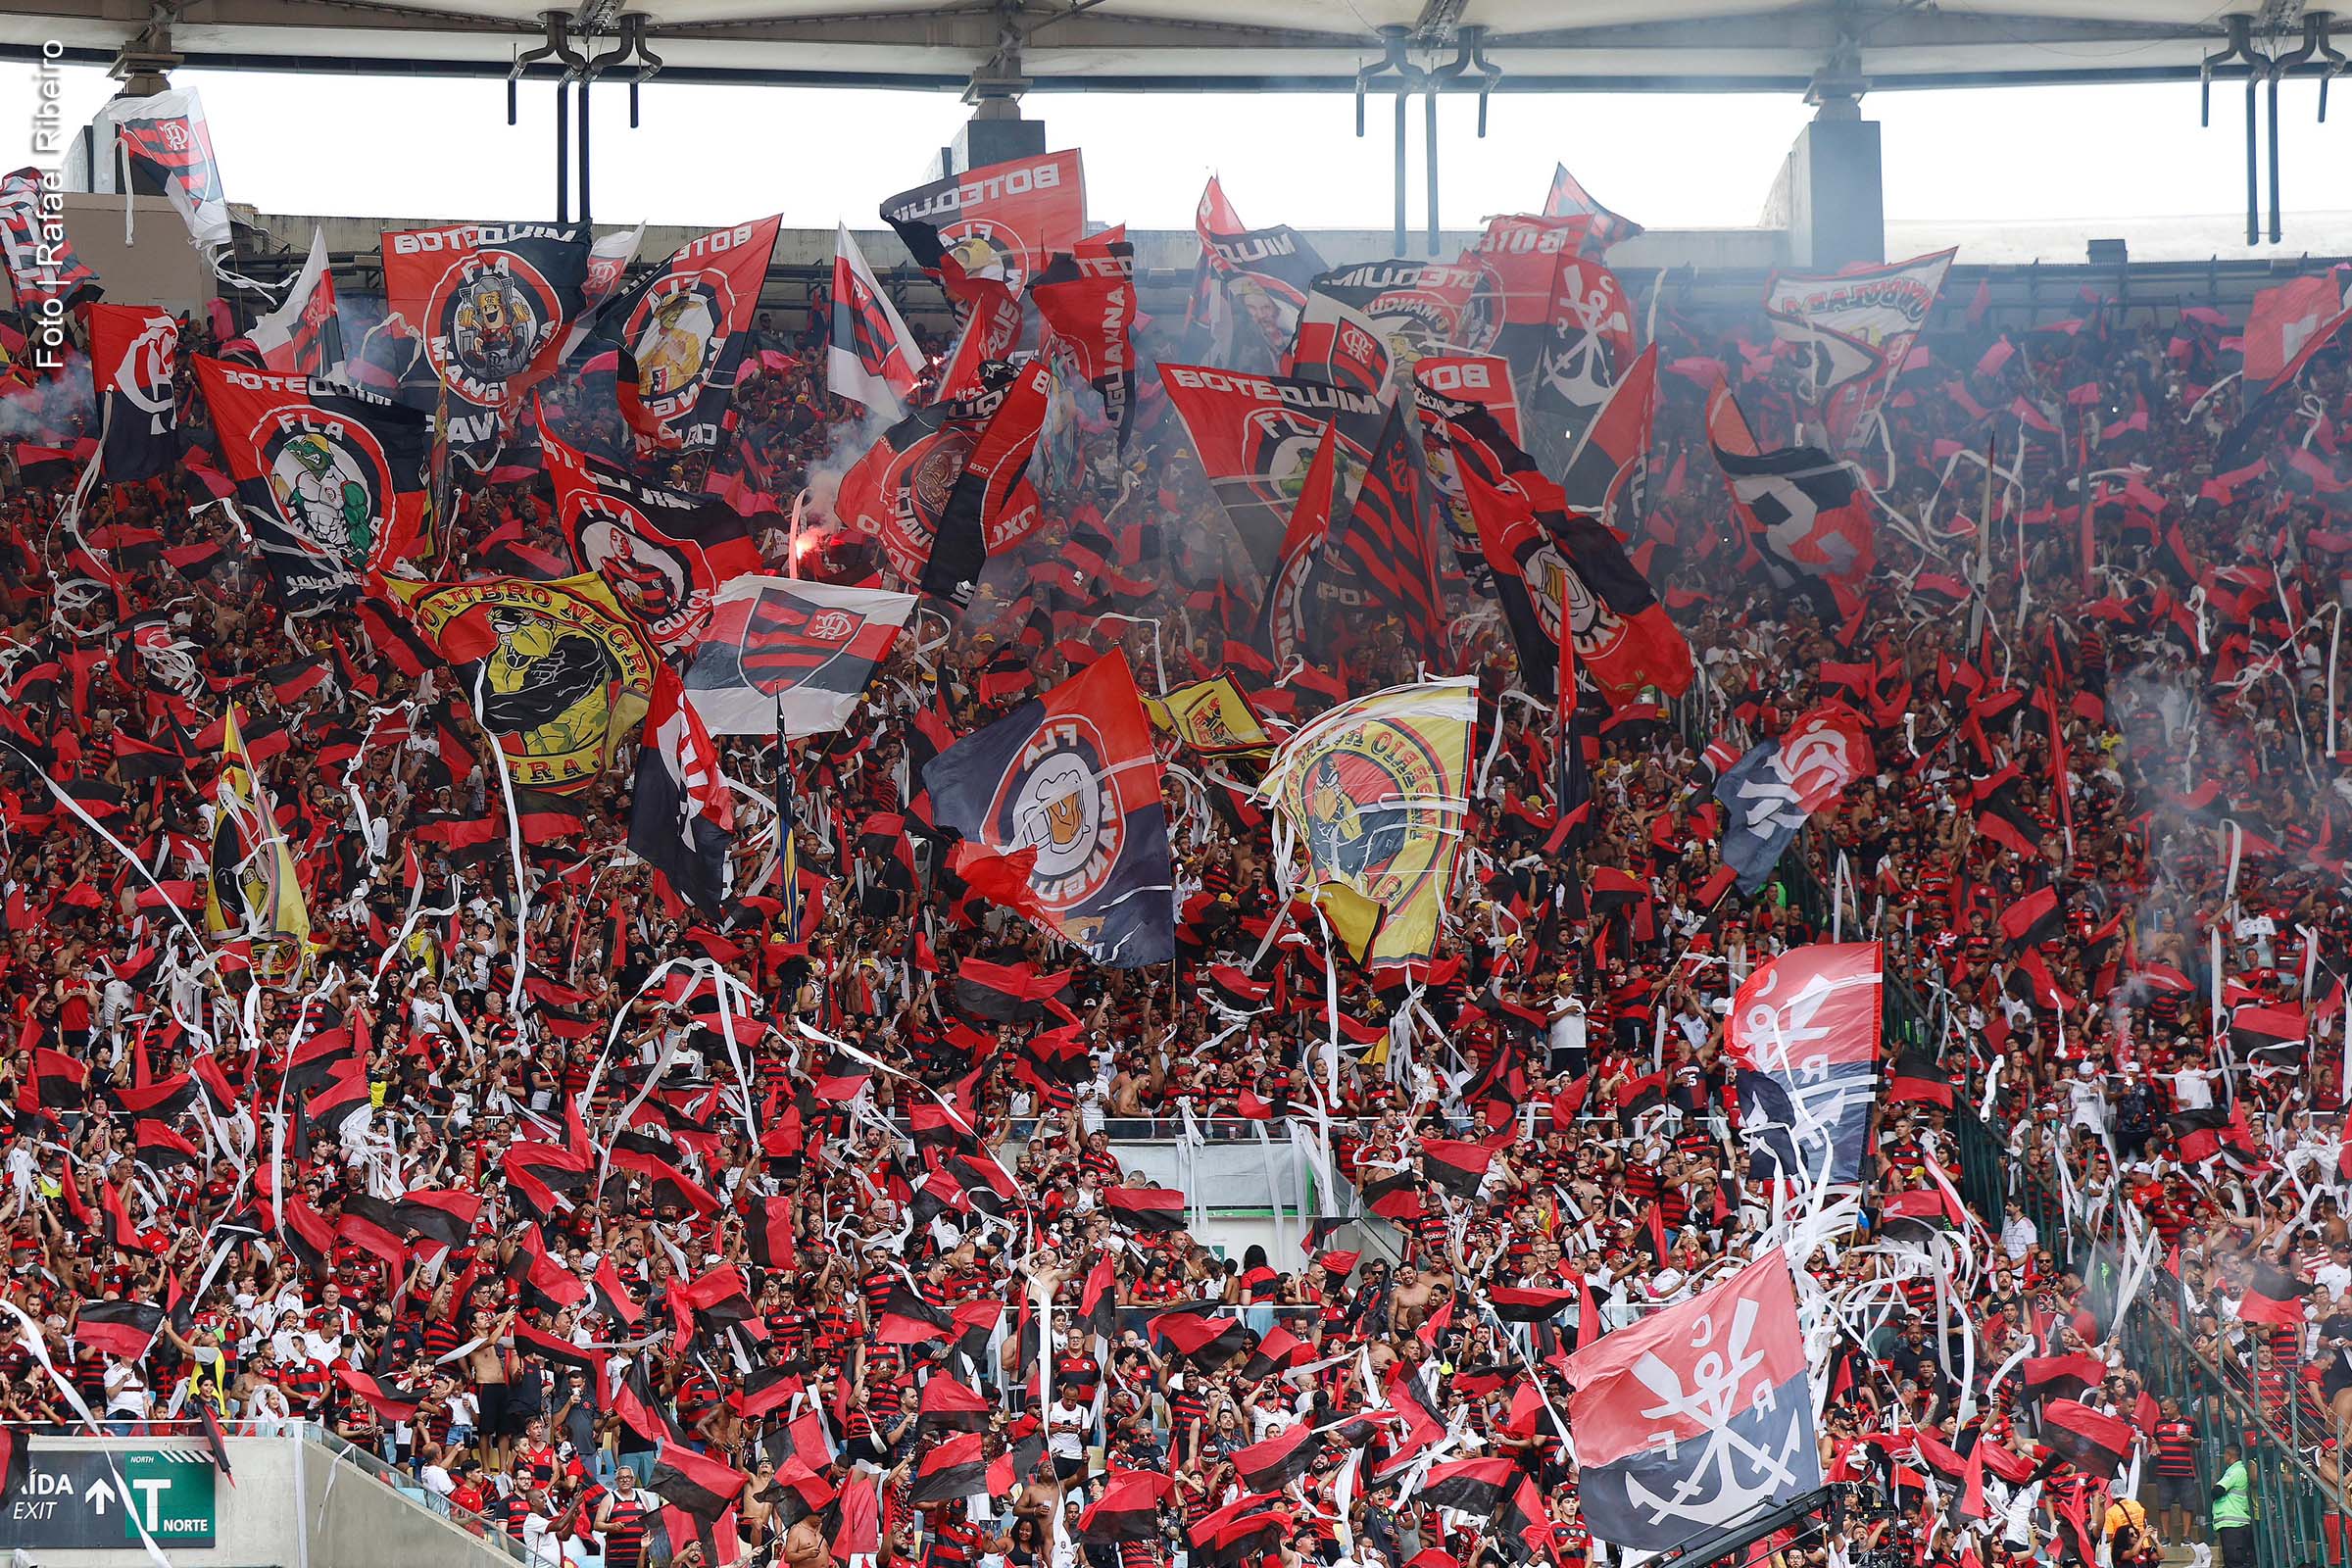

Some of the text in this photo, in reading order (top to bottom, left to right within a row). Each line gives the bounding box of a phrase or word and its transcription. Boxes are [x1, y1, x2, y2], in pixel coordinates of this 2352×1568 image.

[394, 223, 578, 255] BOTEQUIM
[461, 256, 512, 283] FLA
[1171, 368, 1381, 416] BOTEQUIM
[276, 413, 345, 441] FLA
[578, 496, 637, 534] FLA
[130, 1455, 155, 1465] NORTH
[21, 1468, 74, 1495] ÍDA
[13, 1501, 58, 1521] EXIT
[132, 1478, 172, 1533] T
[163, 1518, 209, 1533] NORTE
